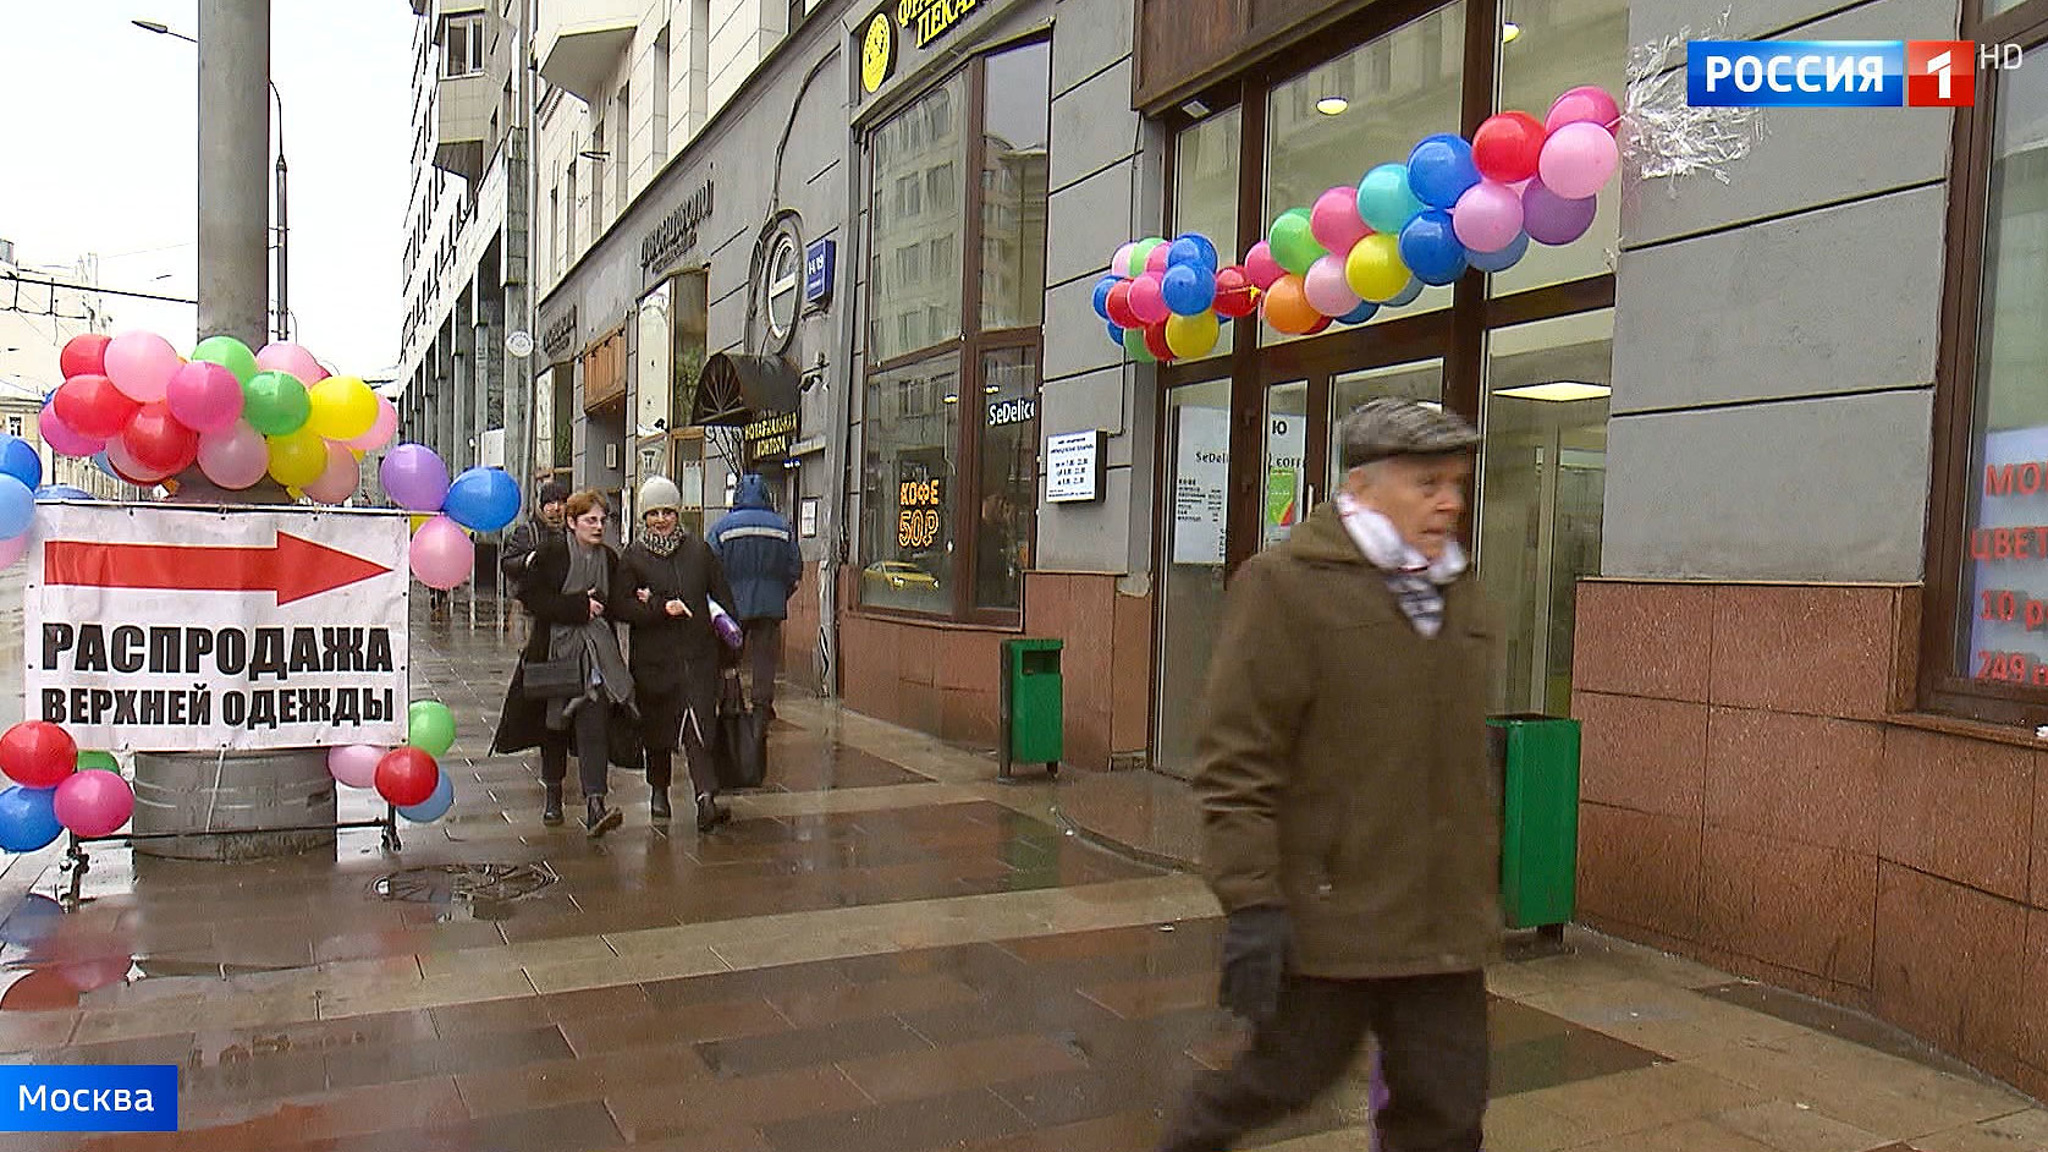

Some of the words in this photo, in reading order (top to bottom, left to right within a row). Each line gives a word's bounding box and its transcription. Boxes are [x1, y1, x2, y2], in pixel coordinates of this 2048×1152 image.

[916, 0, 977, 48] ПЕКА
[900, 479, 939, 506] КОФЕ
[1985, 462, 2048, 498] МО
[1980, 589, 2016, 622] 10
[41, 622, 394, 681] РАСПРОДАЖА
[41, 683, 212, 726] ВЕРХНЕЙ
[222, 687, 394, 730] ОДЕЖДЫ
